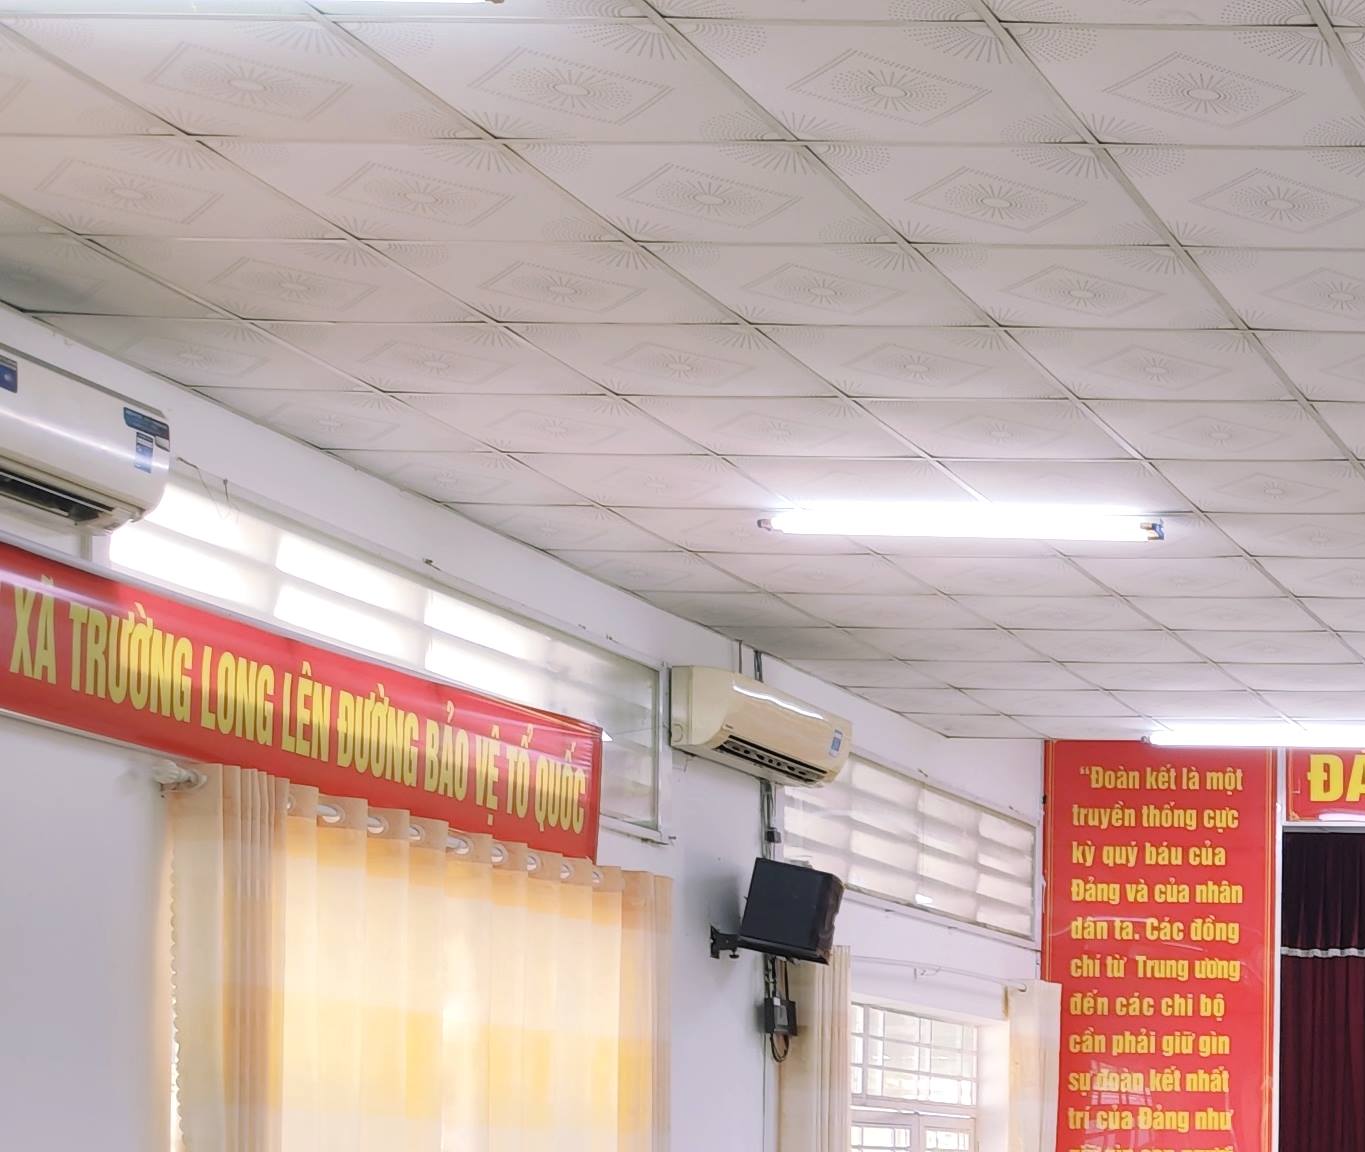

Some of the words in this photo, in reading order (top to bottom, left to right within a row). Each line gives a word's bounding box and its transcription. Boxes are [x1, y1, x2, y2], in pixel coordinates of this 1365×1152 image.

[9, 576, 56, 685] XÃ
[68, 602, 194, 716] TRƯỜNG
[200, 645, 273, 746] LONG
[281, 660, 331, 763] LÊN
[336, 682, 419, 789] ĐƯỜNG
[424, 701, 469, 800] BẢO
[475, 725, 500, 826] VỆ
[507, 724, 534, 818] TỔ
[535, 742, 586, 834] QUỐC
[1146, 764, 1176, 790] kết
[1182, 767, 1199, 790] là
[1206, 767, 1243, 795] một
[1072, 801, 1136, 830] truyền
[1142, 801, 1197, 830] thống
[1203, 807, 1239, 833] cực
[1072, 841, 1095, 867] kỳ
[1145, 842, 1182, 865] báu
[1189, 840, 1226, 866] của
[1071, 876, 1120, 905] Đảng
[1125, 879, 1148, 902] và
[1154, 877, 1190, 903] của
[1196, 880, 1243, 903] nhân
[1070, 989, 1108, 1015] đến
[1115, 992, 1155, 1016] các
[1161, 994, 1193, 1016] chi
[1200, 993, 1225, 1021] bộ
[1069, 1027, 1106, 1053] cần
[1112, 1028, 1155, 1056] phải
[1162, 1031, 1195, 1056] giữ
[1199, 1031, 1230, 1057] gìn
